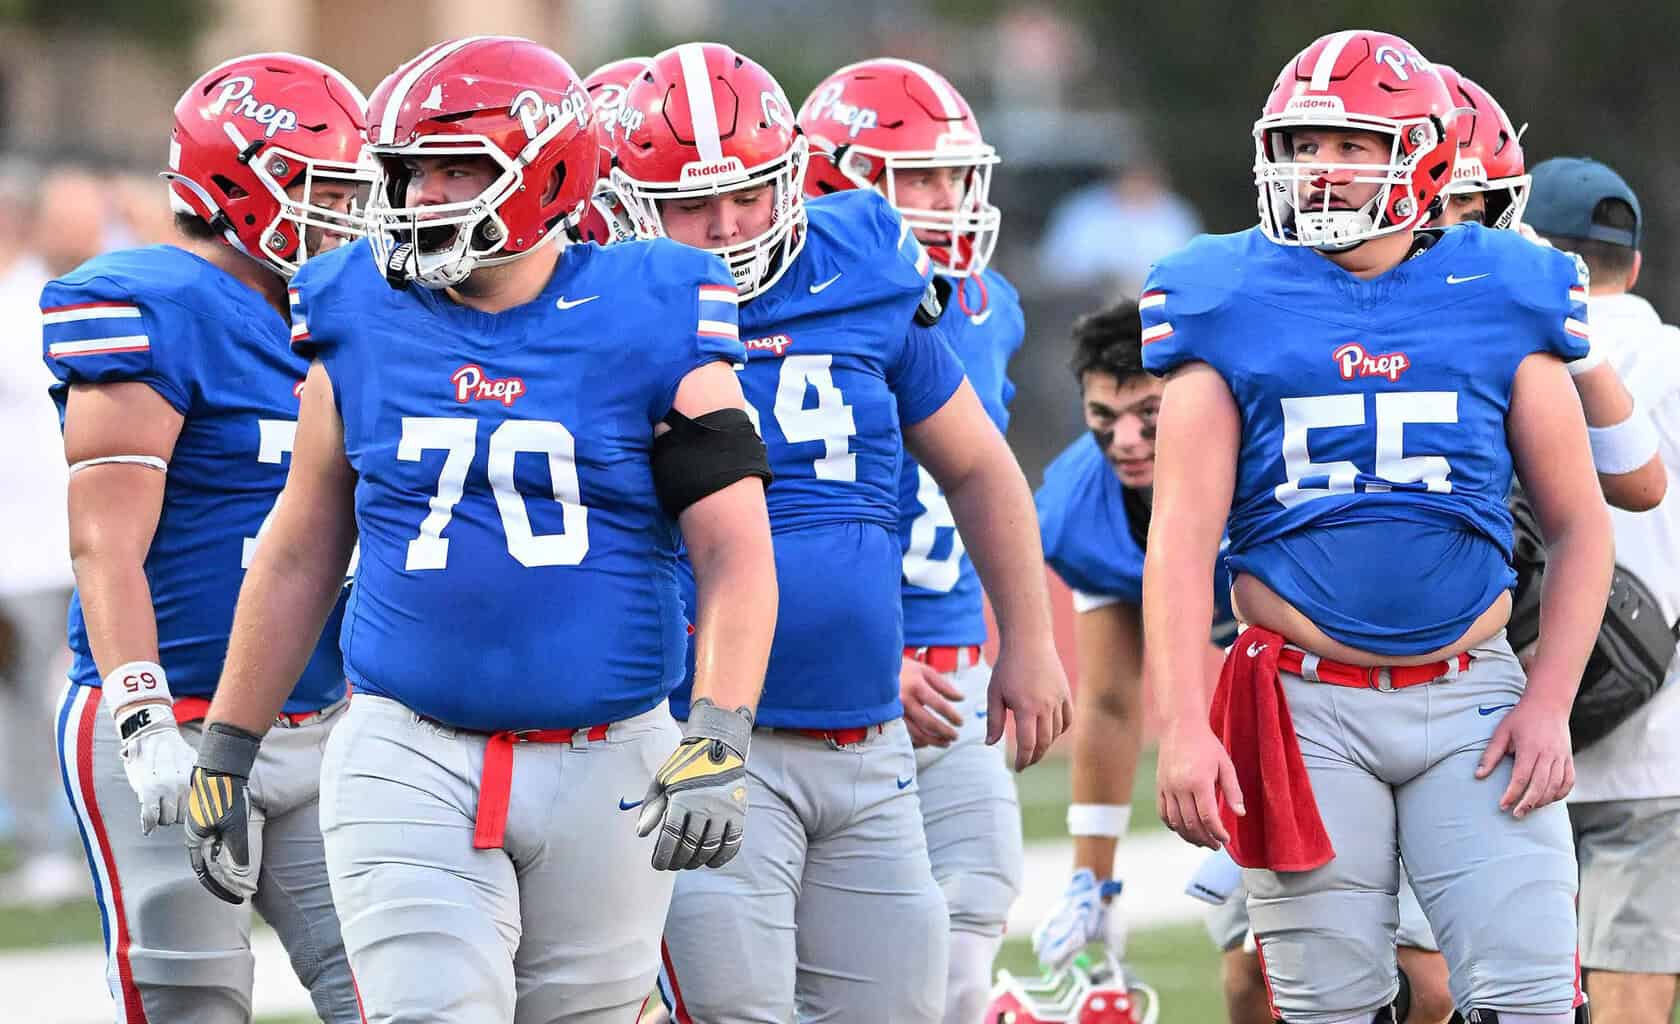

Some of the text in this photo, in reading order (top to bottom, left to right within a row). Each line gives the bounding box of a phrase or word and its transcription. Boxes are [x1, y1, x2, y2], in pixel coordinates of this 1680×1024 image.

[209, 76, 297, 137] Prep
[687, 161, 736, 177] Riddell
[1453, 165, 1481, 179] dell
[1333, 343, 1410, 382] Prep
[450, 364, 527, 407] Prep
[397, 416, 590, 571] 70
[123, 672, 157, 692] 65
